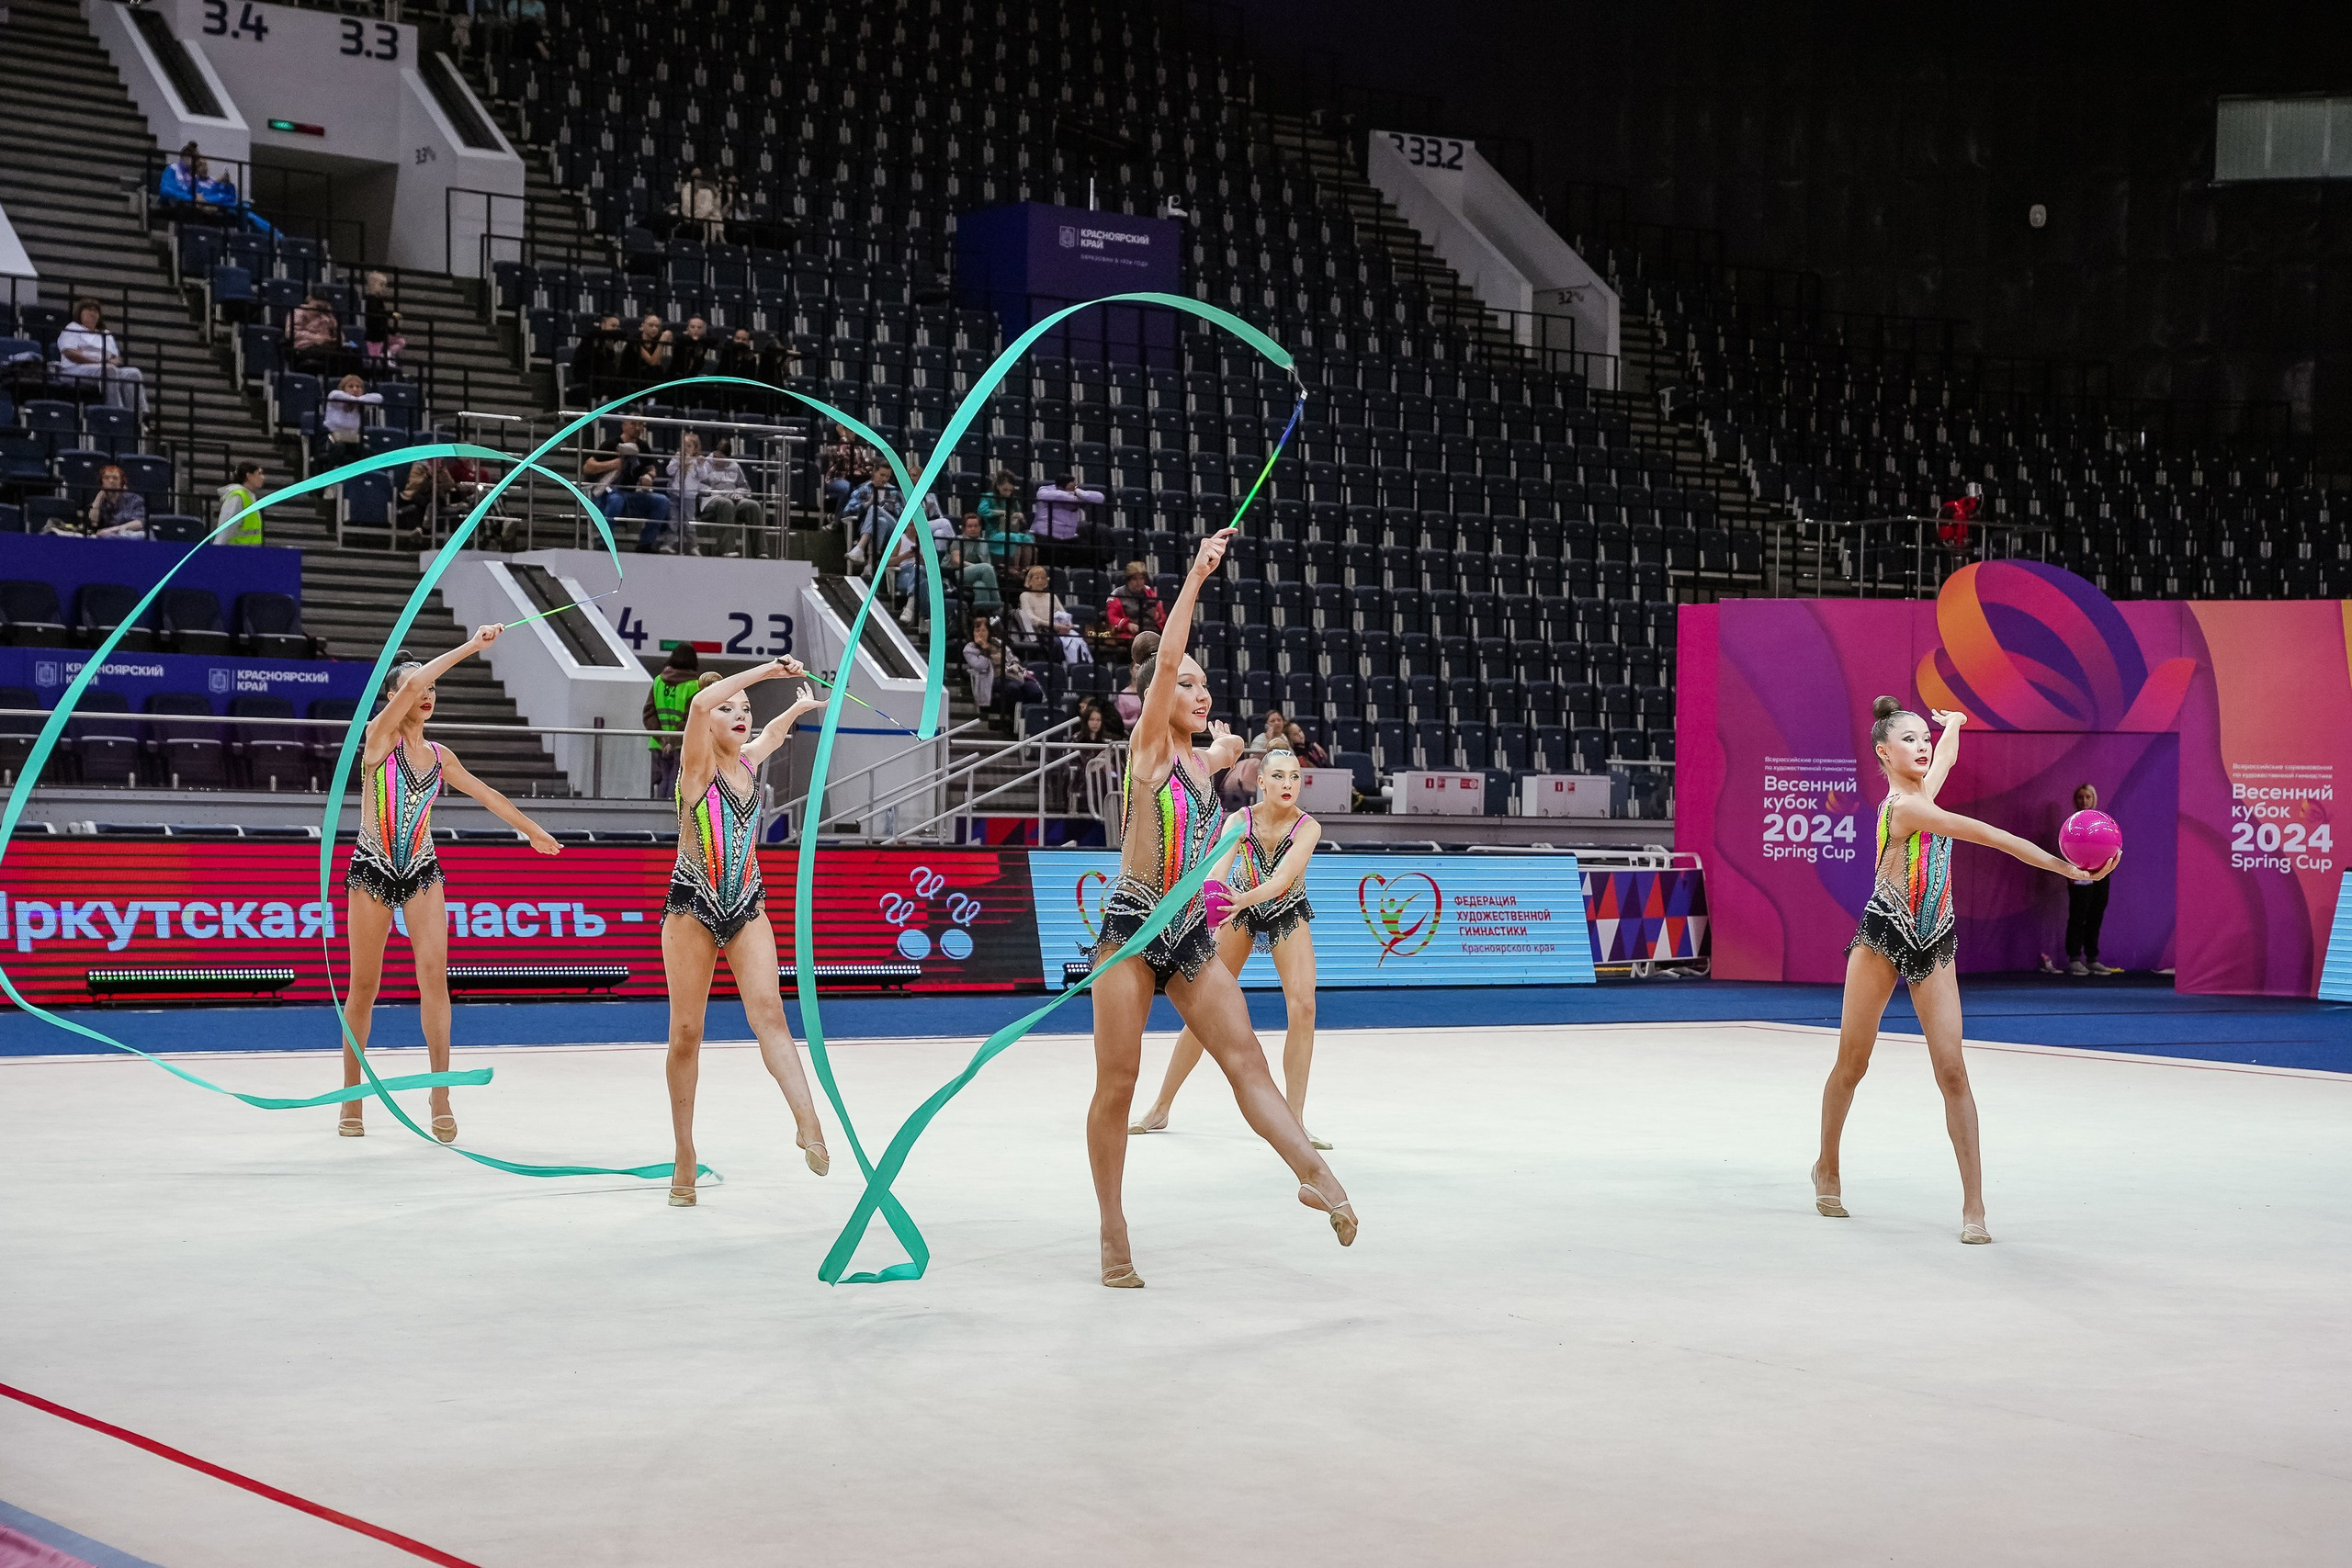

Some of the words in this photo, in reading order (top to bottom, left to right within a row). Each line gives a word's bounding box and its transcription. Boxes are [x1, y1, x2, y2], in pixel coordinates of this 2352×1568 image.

[202, 0, 268, 41] 3.4
[340, 17, 398, 61] 3.3
[1080, 229, 1149, 245] КРАСНОЯРСКИЙ
[1080, 239, 1104, 249] КРАЙ
[726, 612, 793, 655] 2.3
[66, 662, 164, 677] КРНОЯРСКИЙ
[237, 670, 329, 683] КРАСНОЯРСКИЙ
[237, 681, 268, 692] КРАЙ
[1764, 775, 1857, 793] Весенний
[2232, 784, 2334, 800] Весенний
[1764, 794, 1818, 813] кубок
[2232, 802, 2291, 821] кубок
[1763, 814, 1857, 843] 2024
[2232, 822, 2334, 852] 2024
[1763, 843, 1817, 863] Spring
[1822, 845, 1856, 863] Cup
[2232, 853, 2291, 874] Spring
[2295, 854, 2333, 873] Cup
[1454, 896, 1517, 907] ФЕДЕРАЦИЯ
[0, 891, 335, 952] ркутская
[391, 902, 606, 937] ласть
[1457, 908, 1551, 922] ХУДОЖЕСТВЕННОЙ
[1459, 926, 1528, 936] ГИМНАСТИКИ
[1462, 942, 1532, 954] Красноярского
[1534, 943, 1555, 953] края
